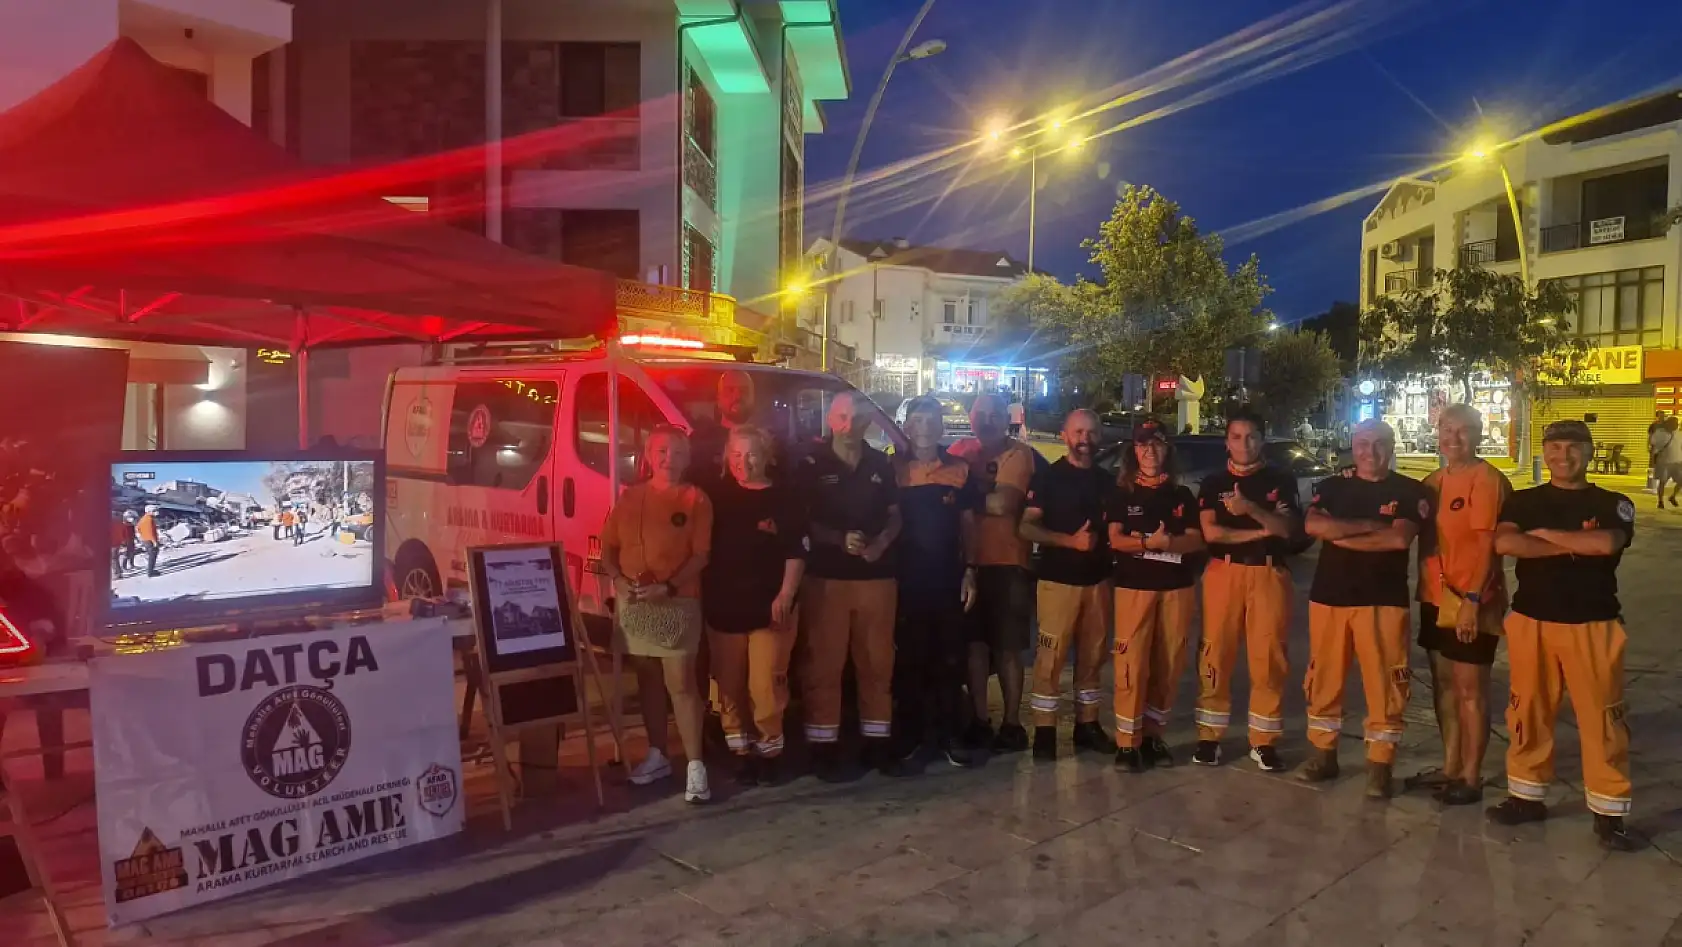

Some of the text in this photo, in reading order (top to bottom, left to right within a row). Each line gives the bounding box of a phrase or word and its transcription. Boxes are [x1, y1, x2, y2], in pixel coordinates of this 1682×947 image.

[196, 635, 379, 697] DATÇA
[253, 747, 345, 796] VOLUNTEER
[272, 743, 324, 778] MAG
[180, 821, 226, 838] MAHALLE
[228, 814, 252, 828] AFET
[194, 793, 406, 879] MAG AME
[197, 872, 242, 893] ARAMA
[244, 855, 303, 881] KURTARMA
[305, 846, 346, 863] SEARCH
[347, 838, 369, 852] AND
[371, 828, 407, 846] RESCUE
